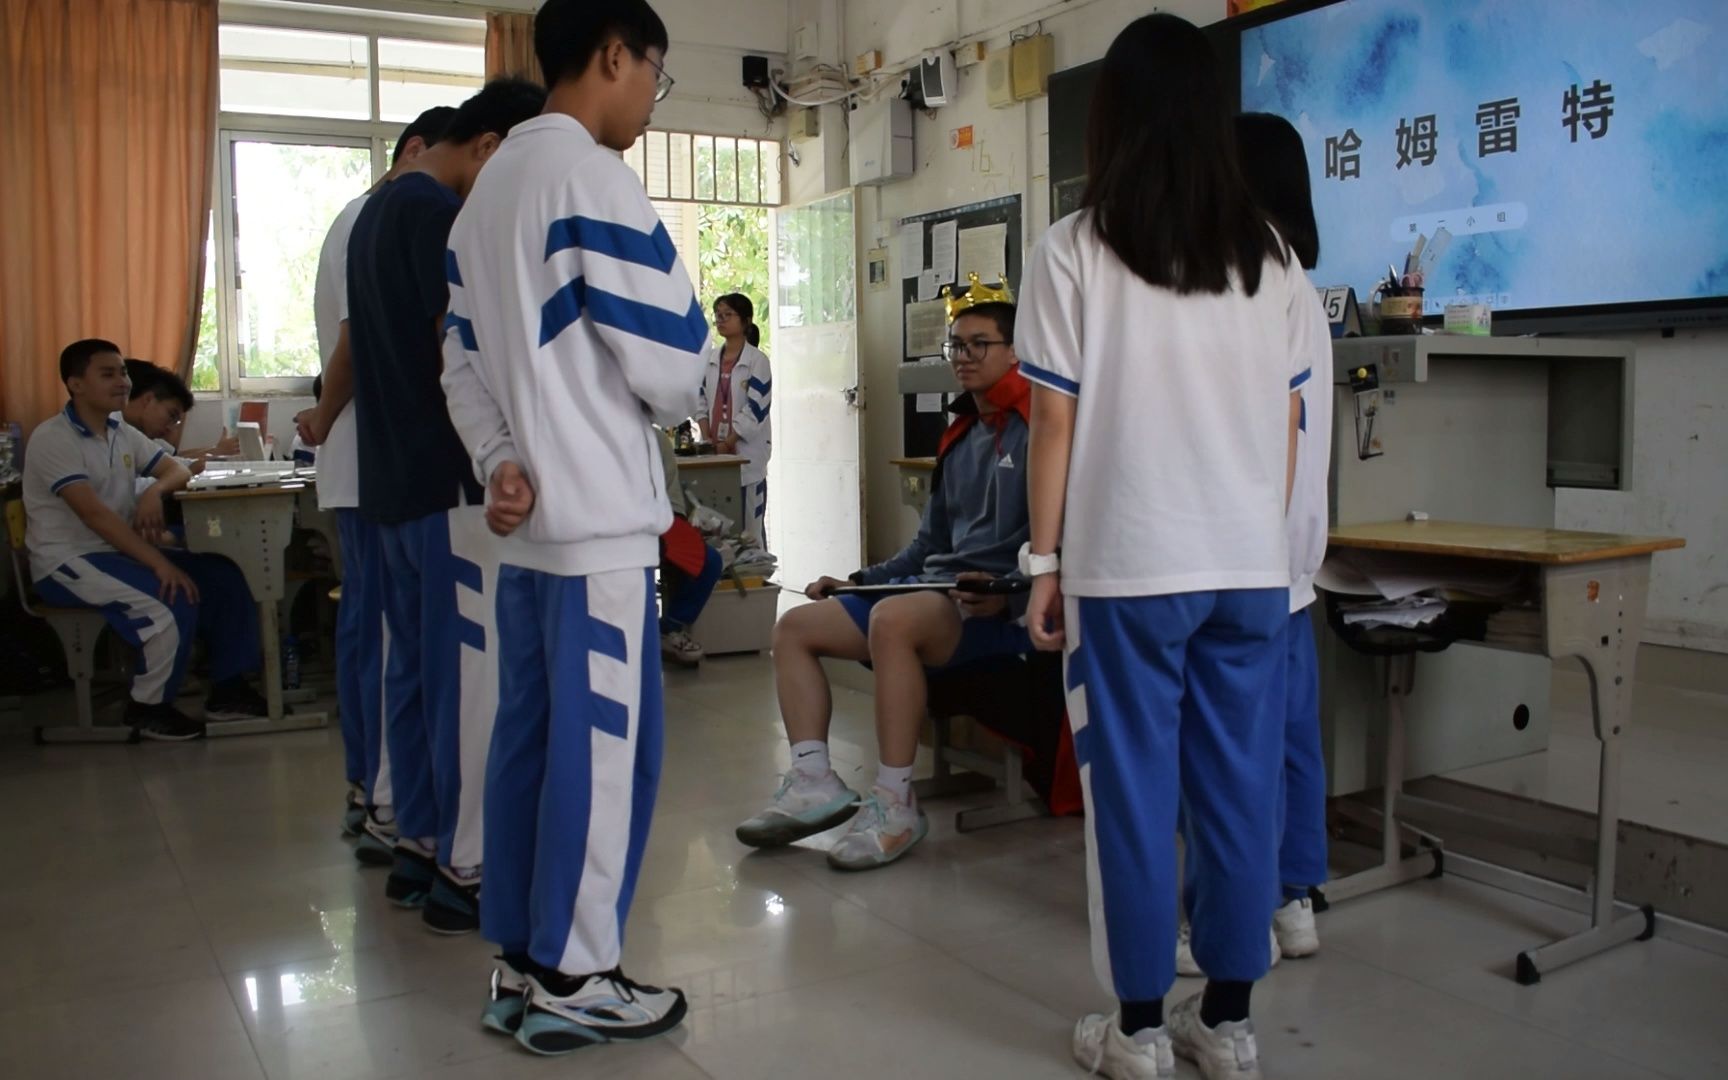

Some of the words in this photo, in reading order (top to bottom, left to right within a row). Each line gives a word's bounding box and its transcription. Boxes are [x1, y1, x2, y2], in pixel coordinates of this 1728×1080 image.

[1325, 79, 1615, 181] 哈姆雷特
[1328, 296, 1341, 319] 5
